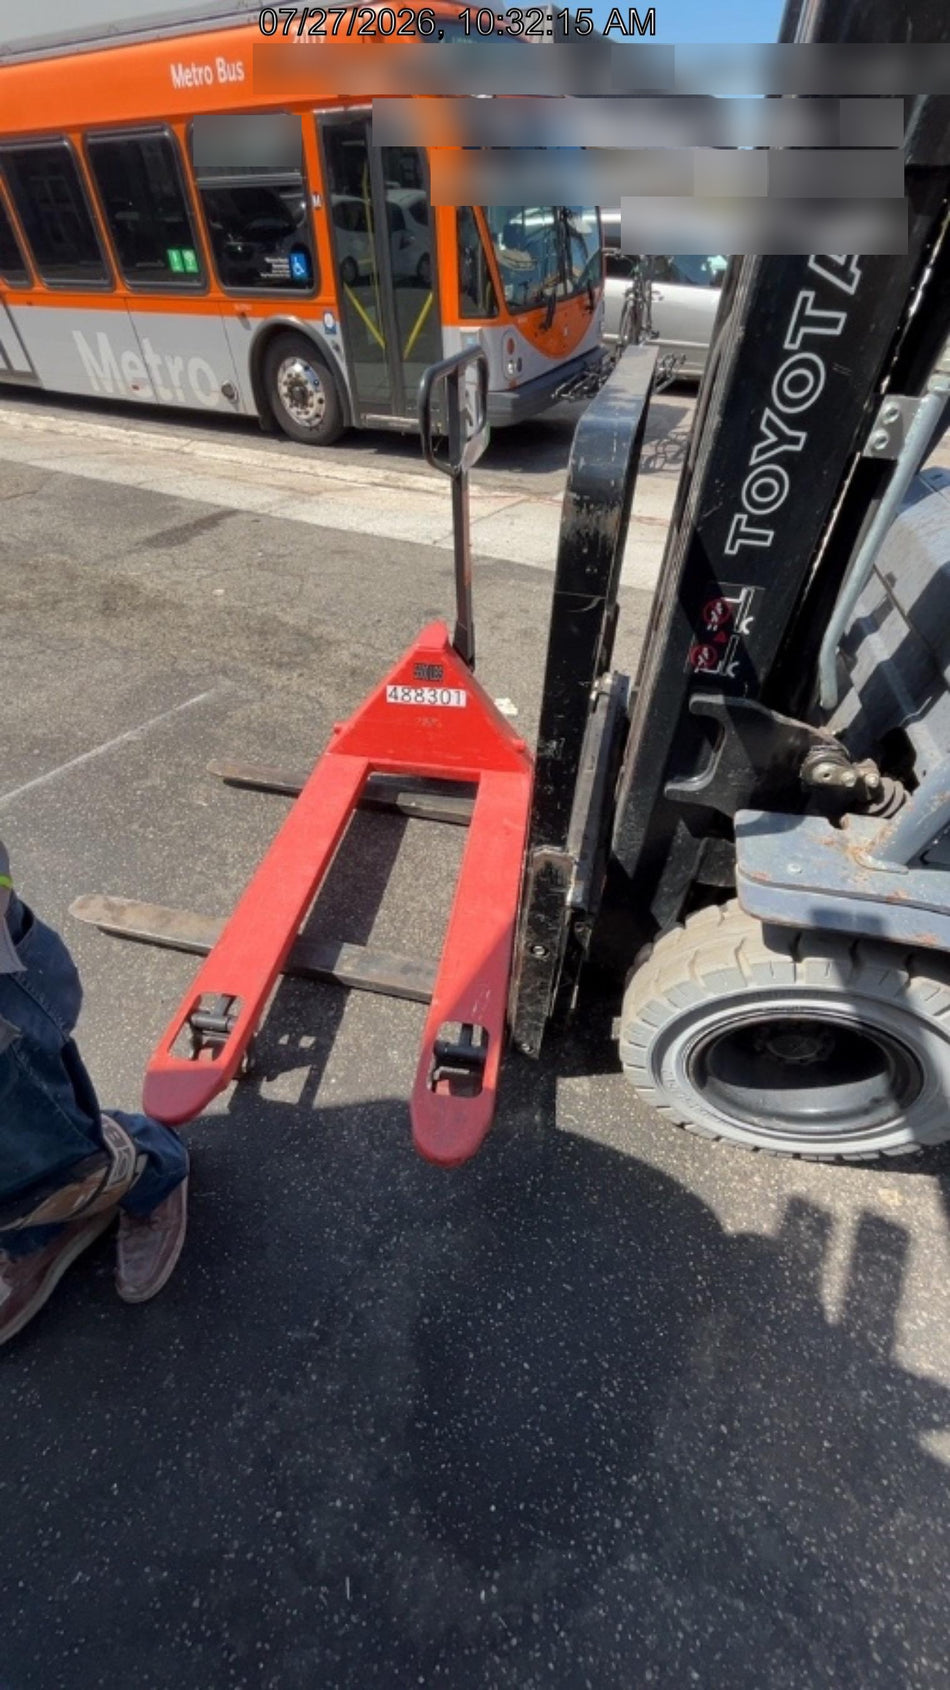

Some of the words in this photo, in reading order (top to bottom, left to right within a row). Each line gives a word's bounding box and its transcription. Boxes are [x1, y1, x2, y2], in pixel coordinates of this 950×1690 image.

[169, 62, 213, 90] Metro
[215, 56, 246, 84] Bus
[72, 330, 221, 407] Metro
[388, 686, 462, 705] 488301
